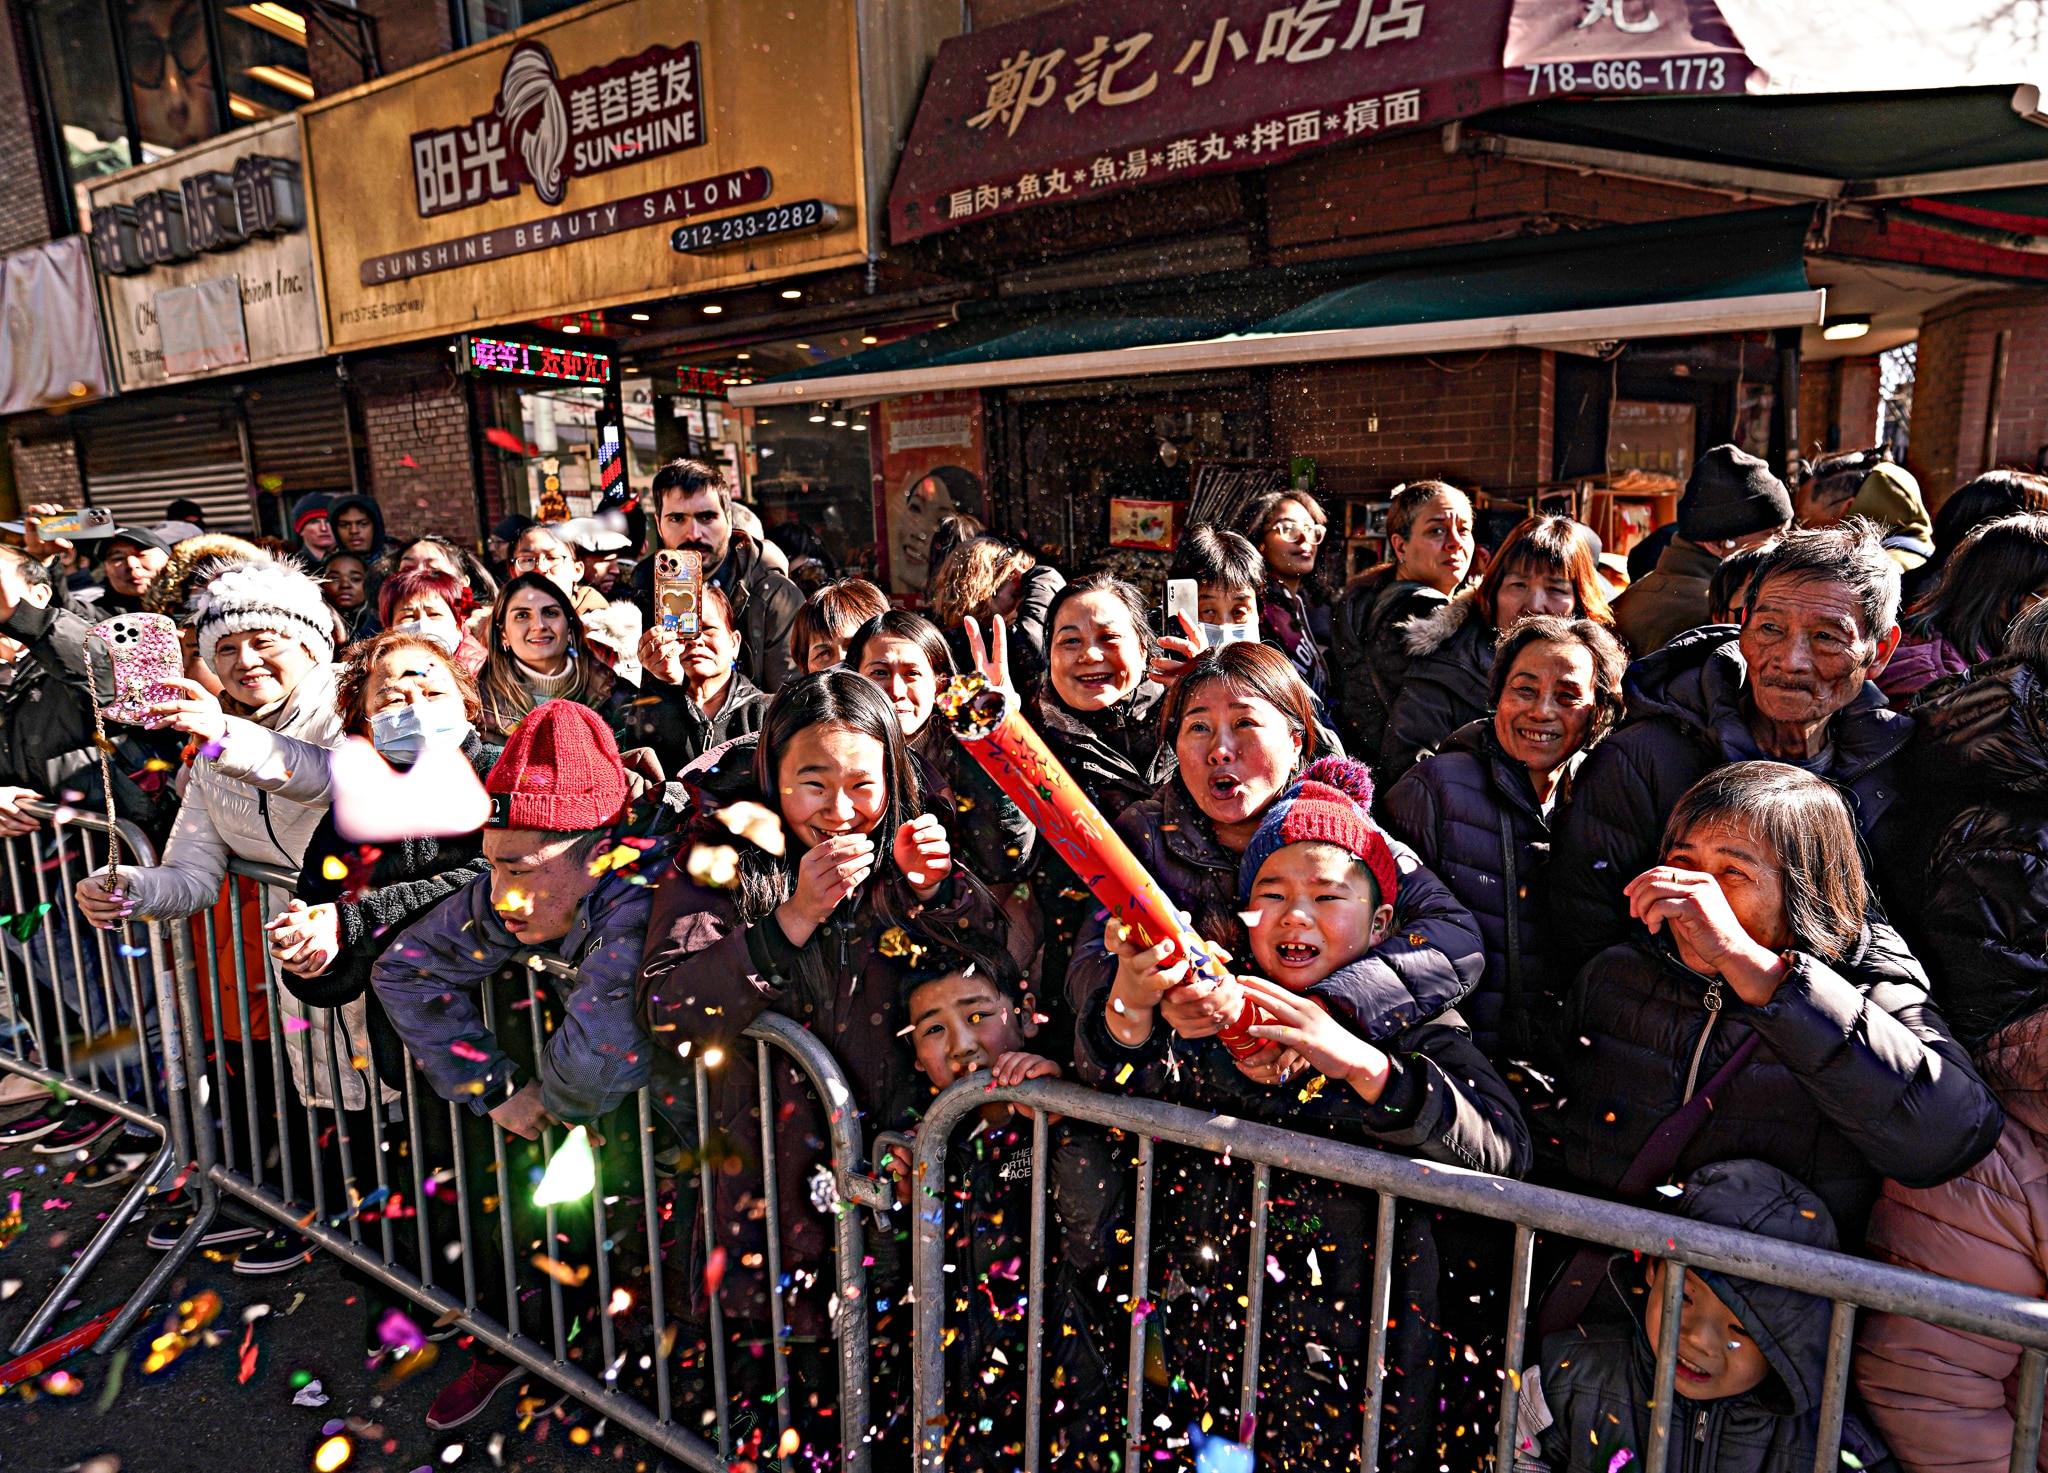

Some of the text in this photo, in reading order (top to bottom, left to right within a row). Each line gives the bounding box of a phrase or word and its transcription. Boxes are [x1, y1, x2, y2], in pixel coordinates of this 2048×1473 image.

[570, 55, 694, 136] 美容美发
[1523, 56, 1726, 96] 718-666-1773
[413, 121, 508, 214] 阳光
[573, 111, 696, 172] SUNSHINE
[376, 177, 742, 279] SUNSHINE BEAUTY SALON
[678, 203, 816, 250] 212-233-2282
[1011, 1147, 1031, 1160] THE
